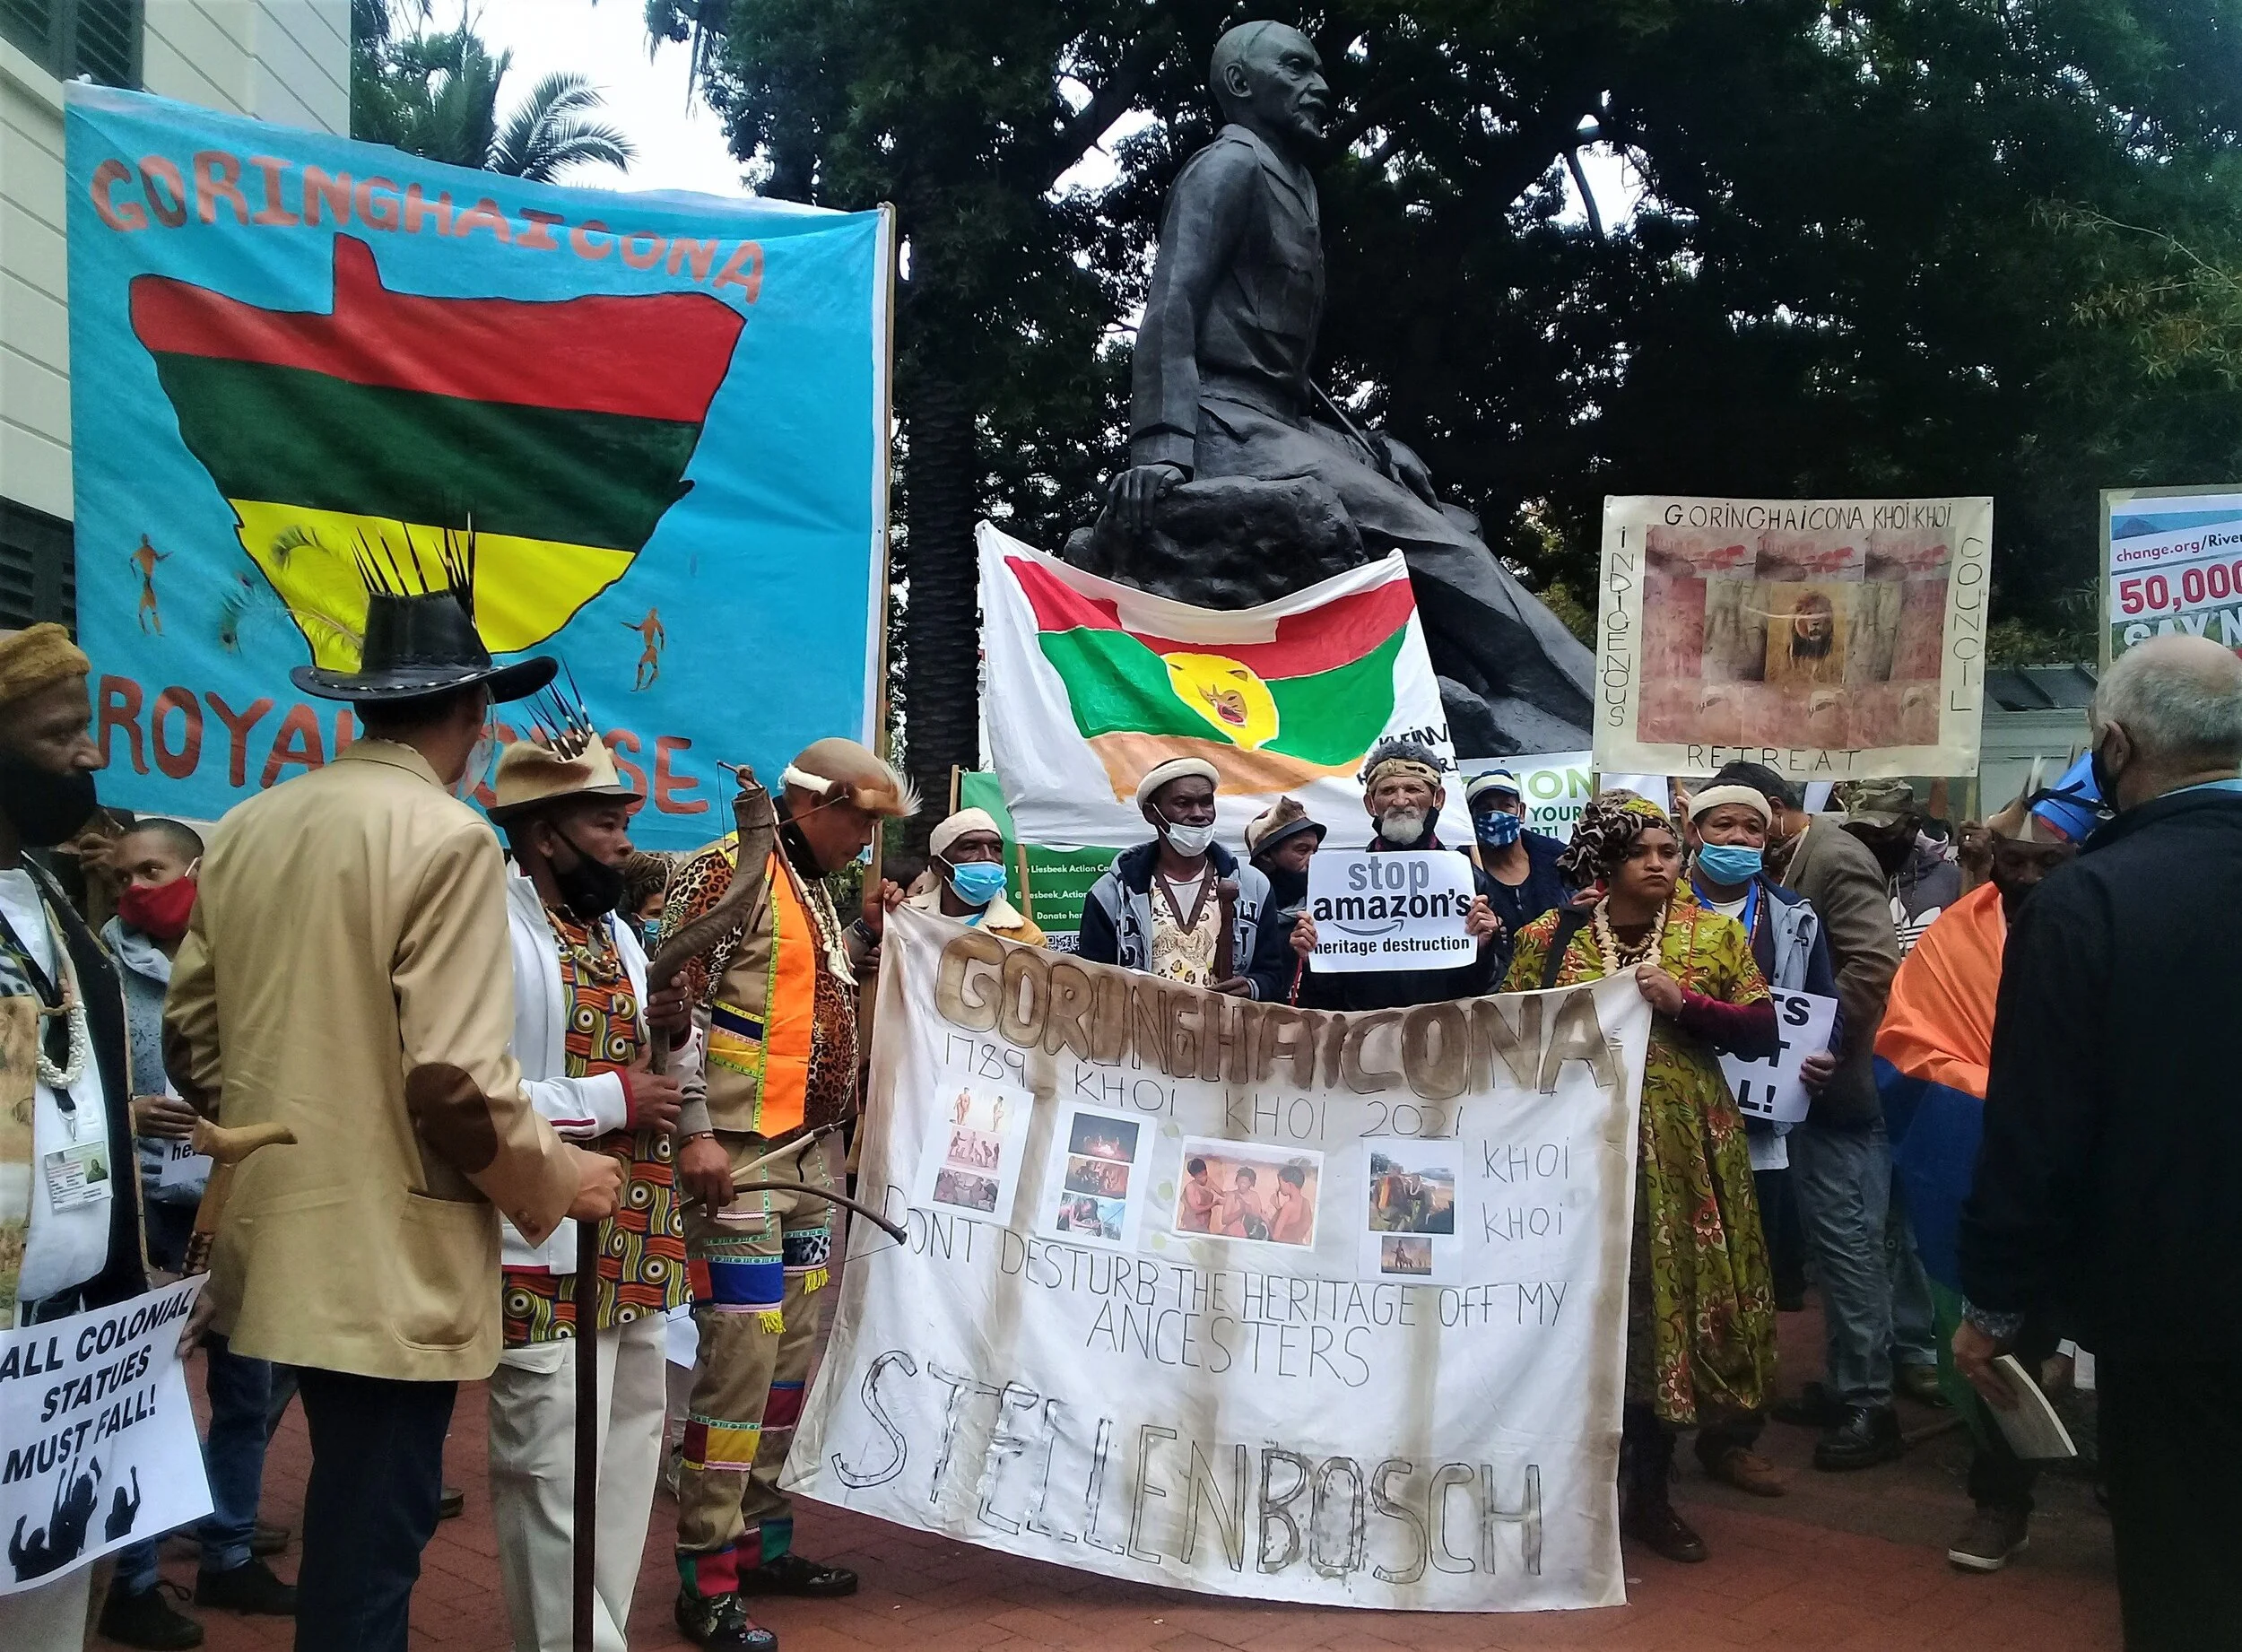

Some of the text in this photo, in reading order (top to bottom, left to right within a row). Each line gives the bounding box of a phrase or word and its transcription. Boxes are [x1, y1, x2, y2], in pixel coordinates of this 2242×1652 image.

[91, 150, 764, 305] GORINGHAICONA
[1688, 743, 1861, 771] RETREAT
[1069, 864, 1096, 873] Action
[1313, 888, 1471, 921] amazon's
[1348, 856, 1429, 896] stop
[1037, 911, 1067, 920] Donate
[1383, 935, 1470, 952] destruction
[945, 1031, 1027, 1088] 1789
[1359, 1100, 1464, 1138] 2021
[883, 1184, 983, 1263] DONT
[1000, 1229, 1160, 1307] DESTURB
[1170, 1266, 1228, 1312] THE
[1517, 1281, 1568, 1327] MY
[0, 1287, 194, 1383] ALL COLONIAL
[1085, 1299, 1372, 1388] ANCESTERS
[40, 1343, 152, 1423] STATUES
[0, 1383, 156, 1485] MUST FALL!
[831, 1349, 1543, 1585] STELLENBOSCH
